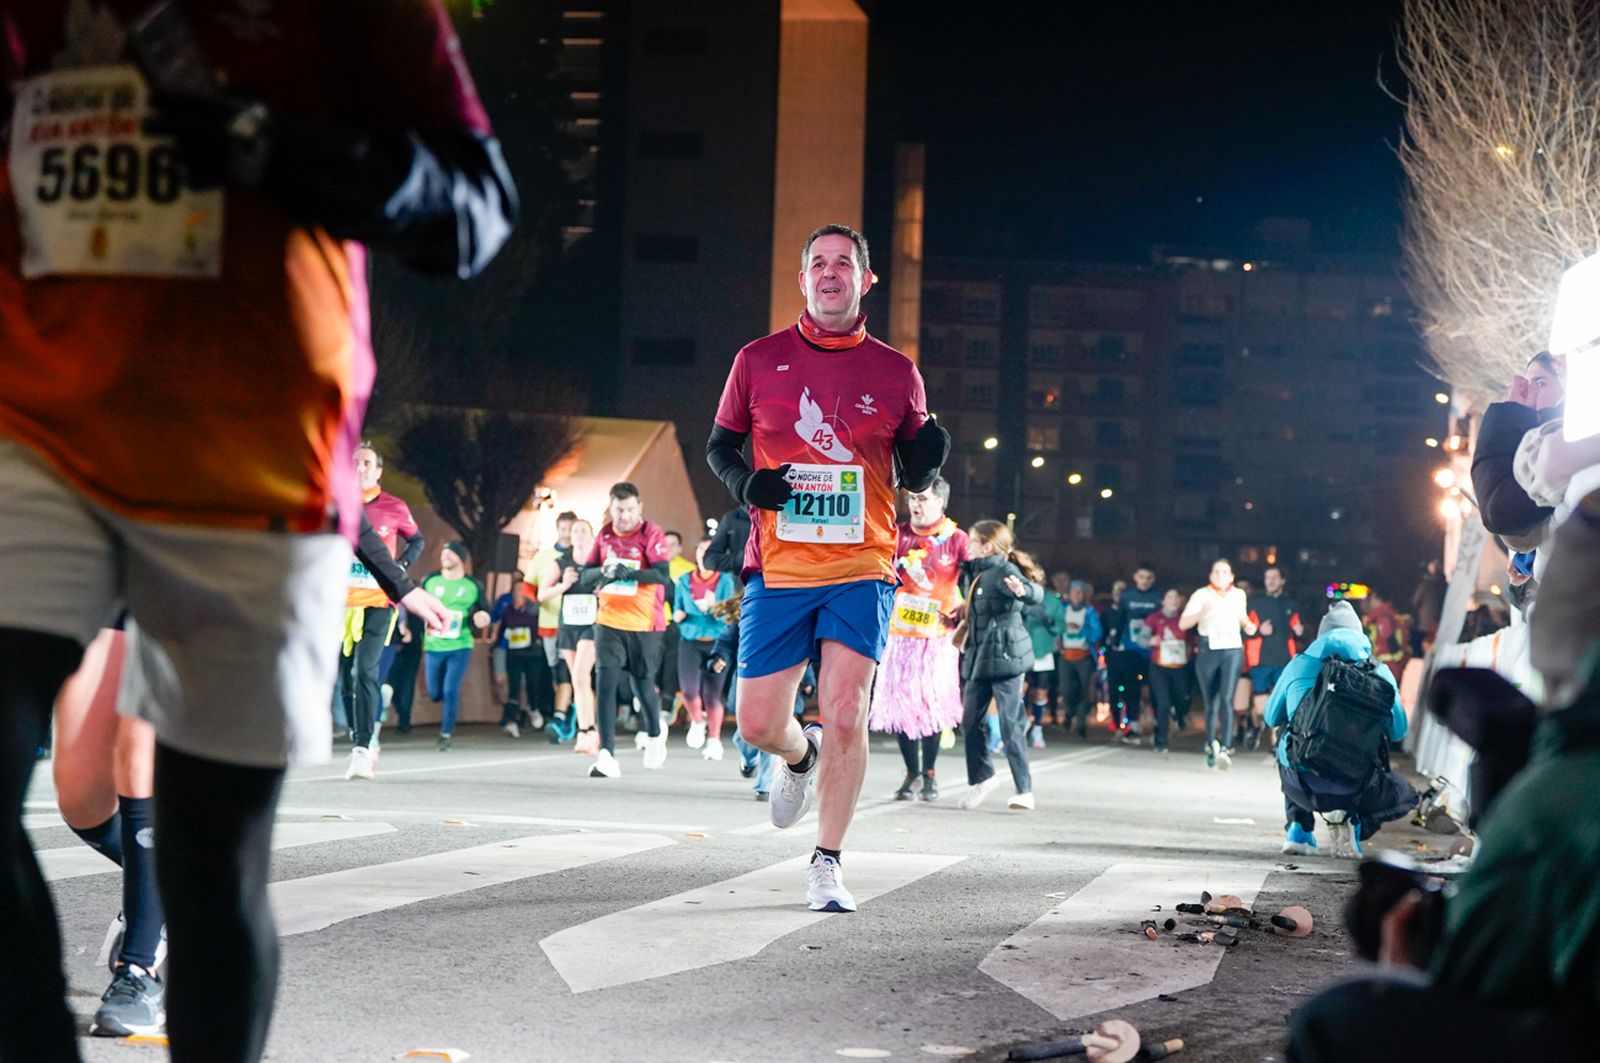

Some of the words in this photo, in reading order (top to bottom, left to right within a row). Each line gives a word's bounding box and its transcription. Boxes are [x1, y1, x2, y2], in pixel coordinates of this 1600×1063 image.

[812, 429, 833, 450] 43
[797, 473, 821, 482] NOCHE
[822, 474, 833, 482] DE
[791, 493, 850, 517] 12110
[903, 608, 930, 624] 2838
